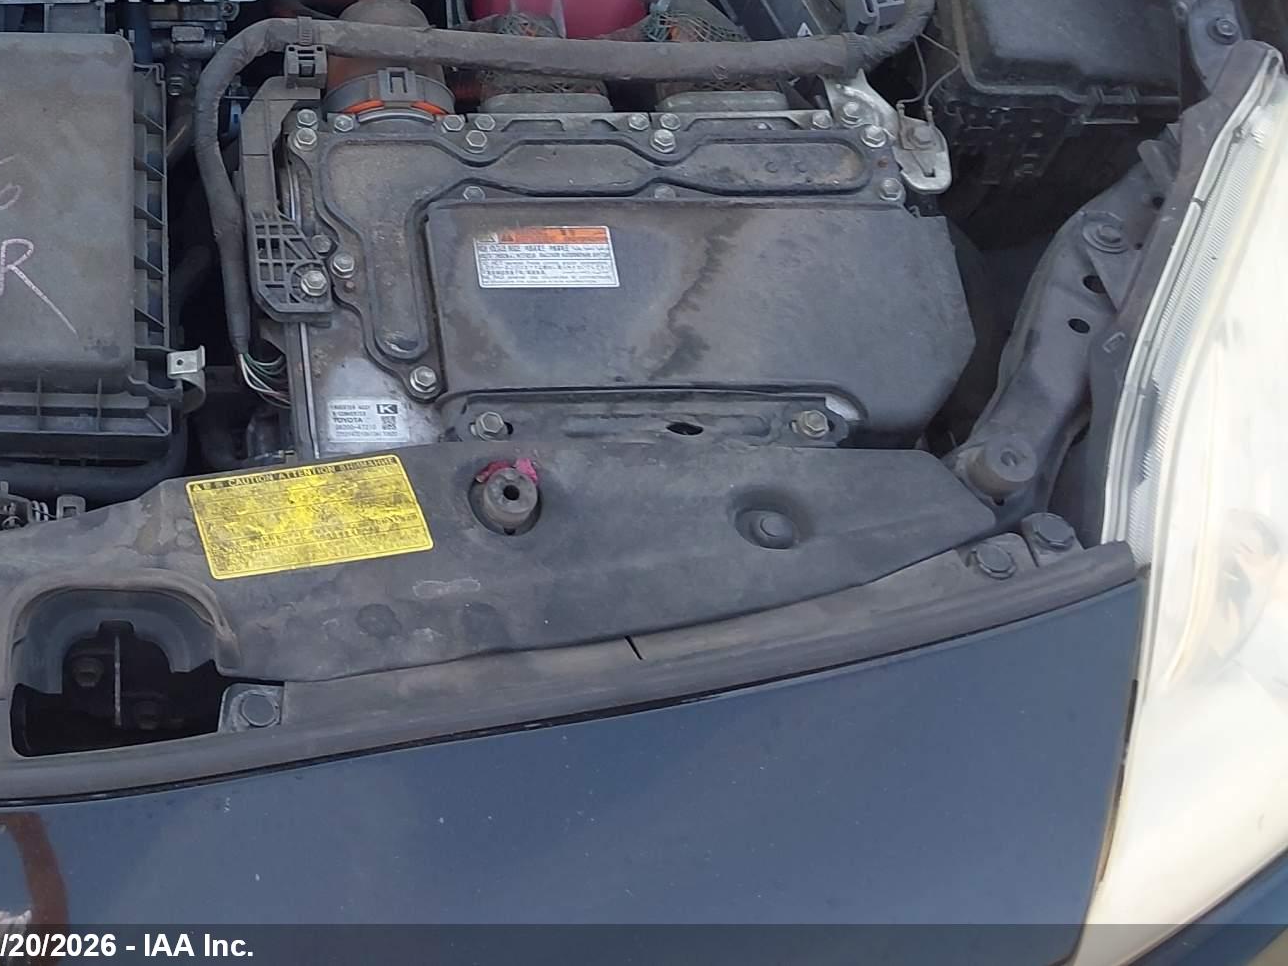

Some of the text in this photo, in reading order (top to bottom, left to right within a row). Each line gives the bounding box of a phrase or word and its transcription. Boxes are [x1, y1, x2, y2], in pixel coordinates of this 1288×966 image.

[377, 404, 397, 414] K
[229, 473, 274, 488] CAUTION
[278, 466, 336, 481] ATTENTION
